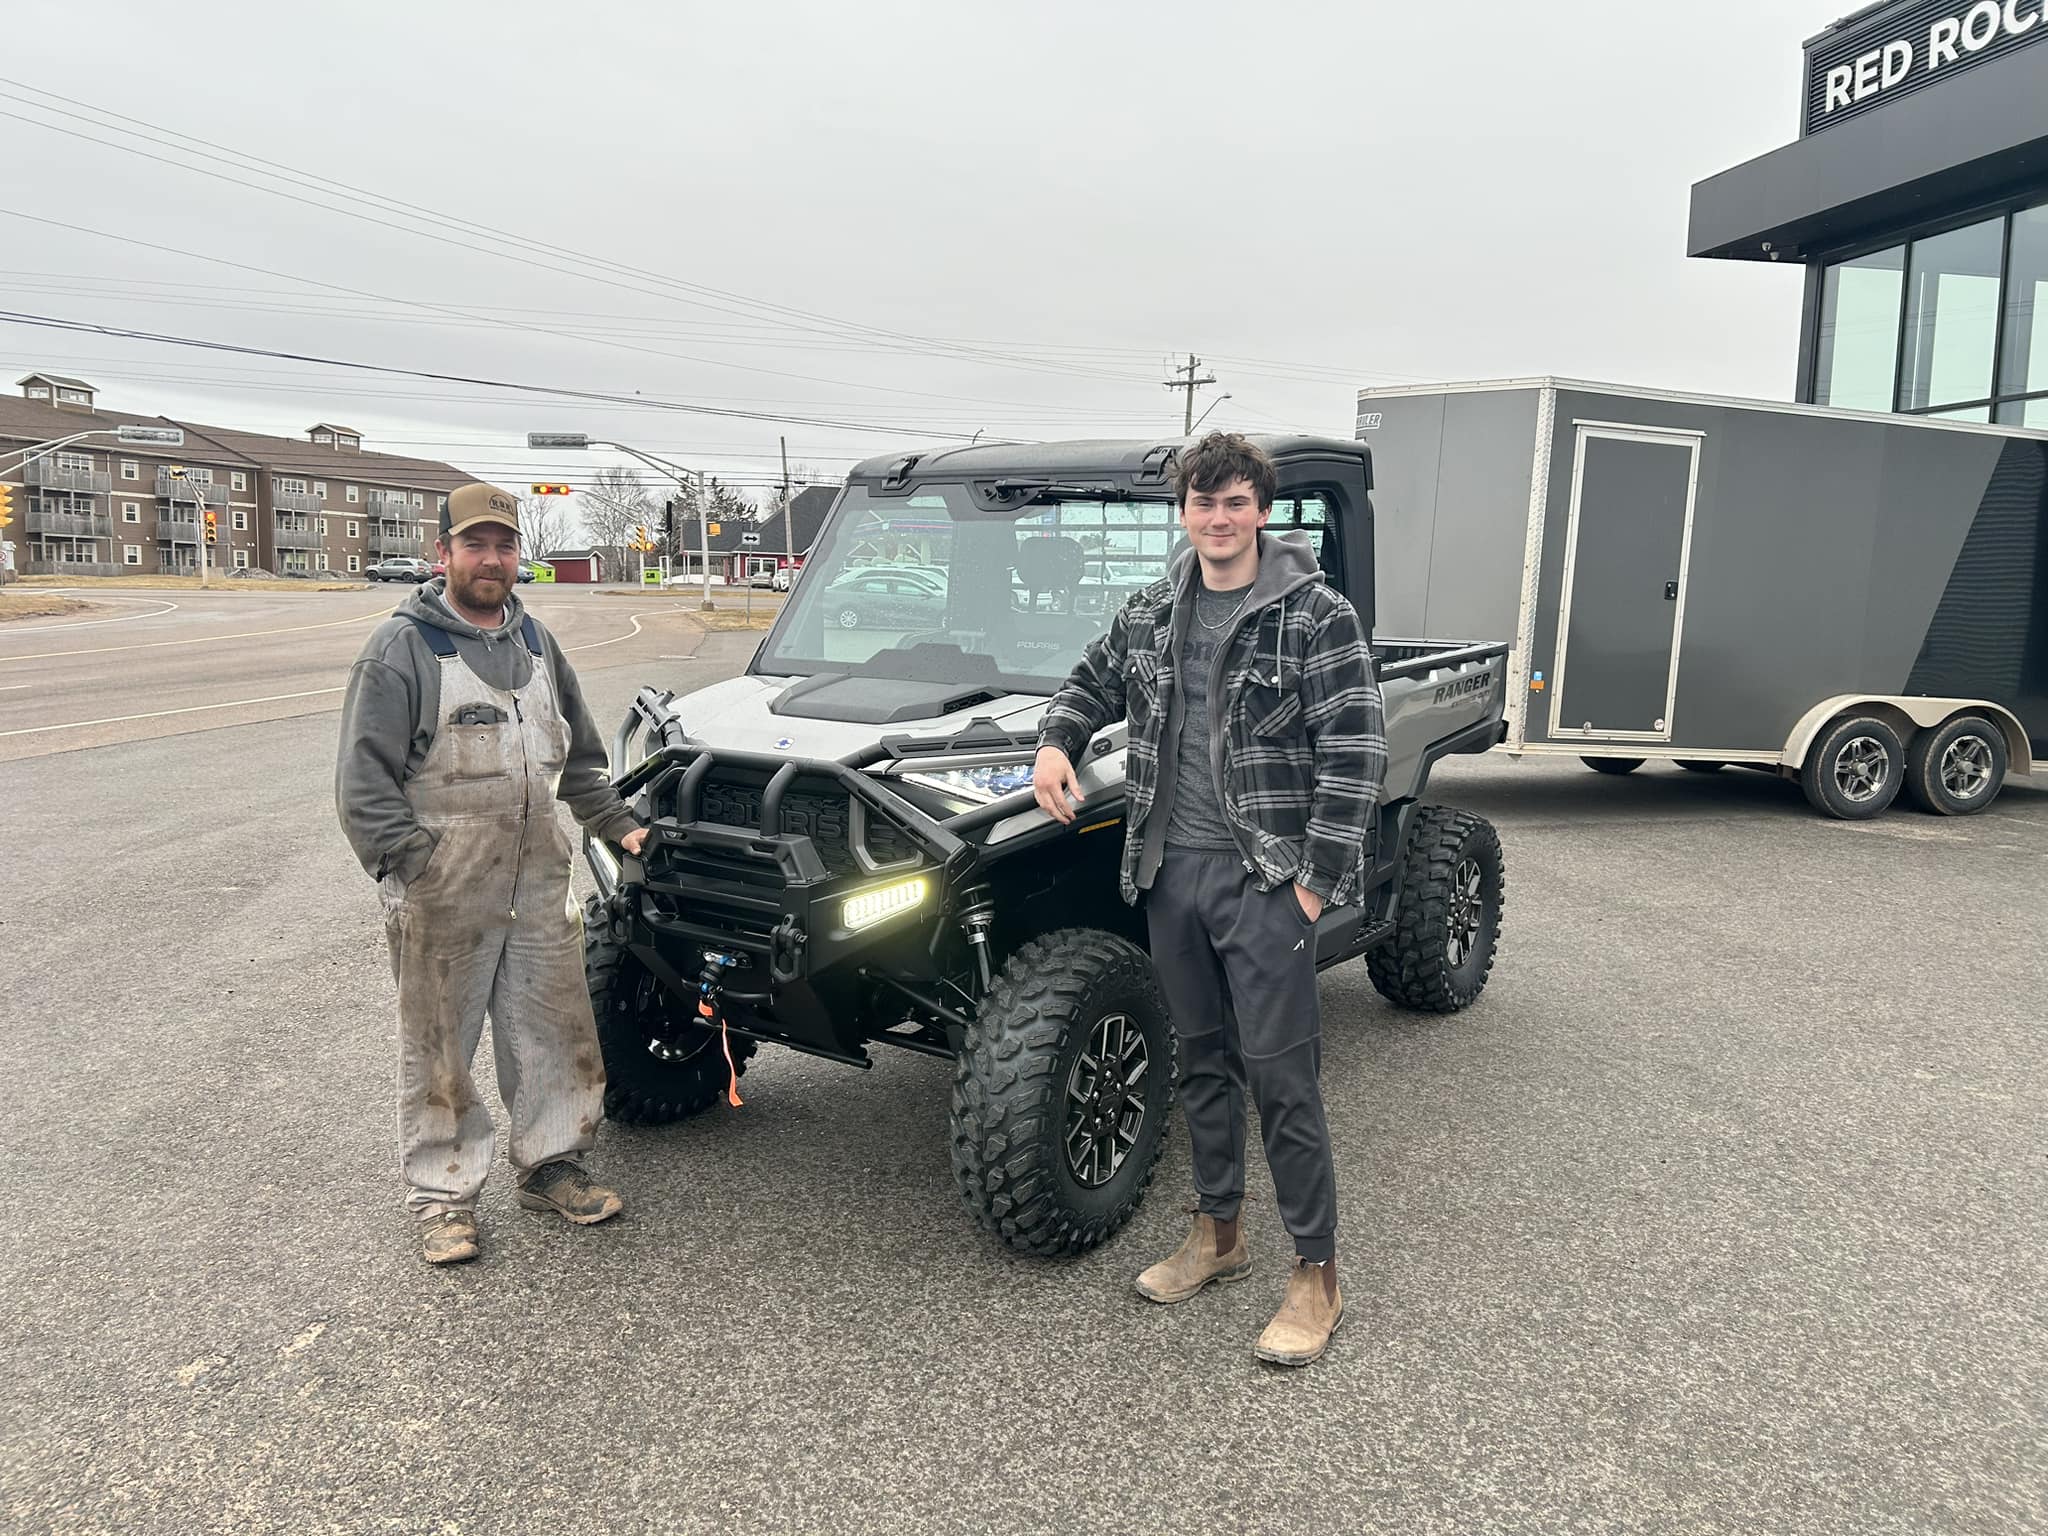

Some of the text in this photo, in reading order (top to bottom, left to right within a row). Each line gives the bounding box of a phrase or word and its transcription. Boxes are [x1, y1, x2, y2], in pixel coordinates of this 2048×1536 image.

[1825, 0, 2048, 113] RED ROC
[1432, 671, 1490, 705] RANGER
[702, 797, 842, 839] POLRIS
